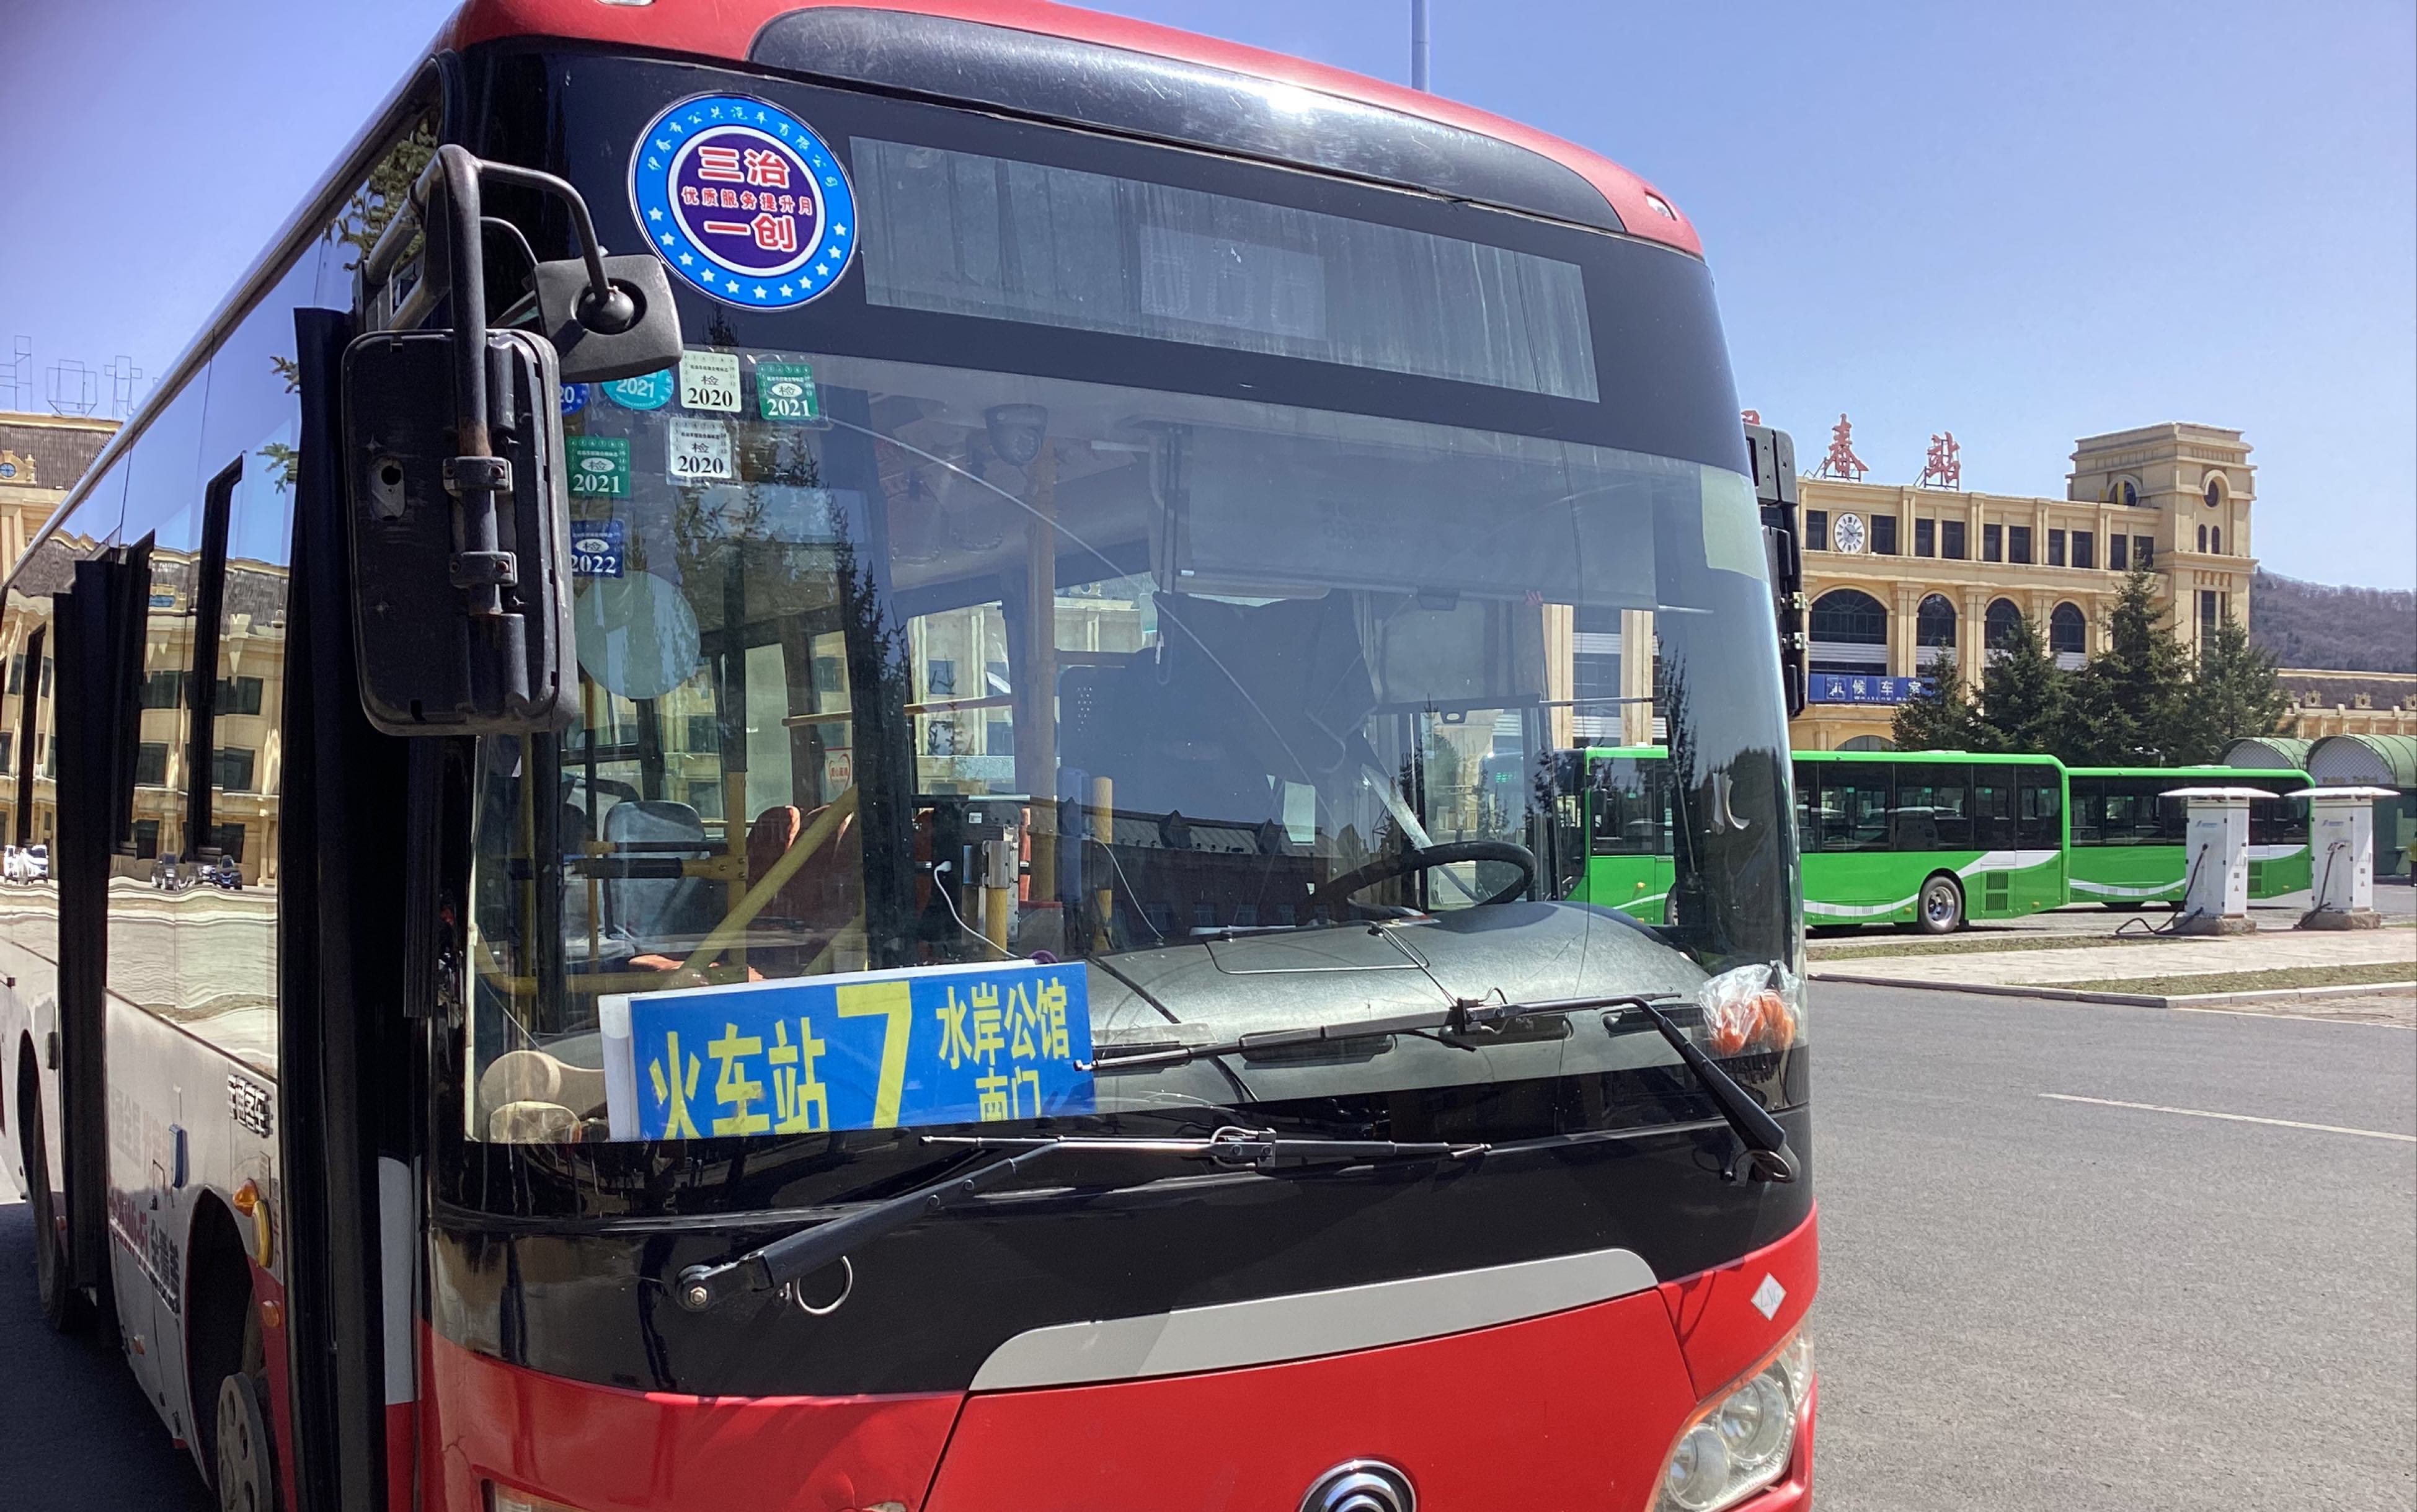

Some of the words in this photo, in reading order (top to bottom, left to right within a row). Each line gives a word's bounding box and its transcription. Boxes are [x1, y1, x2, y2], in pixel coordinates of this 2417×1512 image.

[698, 146, 791, 187] 三治
[681, 187, 814, 216] 优质服务提升月
[704, 213, 797, 252] 一创
[616, 378, 655, 399] 2021
[701, 374, 720, 385] 检
[687, 387, 733, 407] 2020
[779, 385, 796, 396] 检
[766, 398, 811, 417] 2021
[691, 442, 709, 453] 检
[588, 460, 607, 471] 检
[677, 455, 724, 474] 2020
[572, 474, 621, 493] 2021
[582, 541, 601, 552] 检
[570, 555, 616, 574] 2022
[936, 976, 1070, 1070] 水岸公馆
[835, 981, 912, 1129] 7
[649, 1017, 829, 1141] 火车站
[975, 1066, 1042, 1121] 南门
